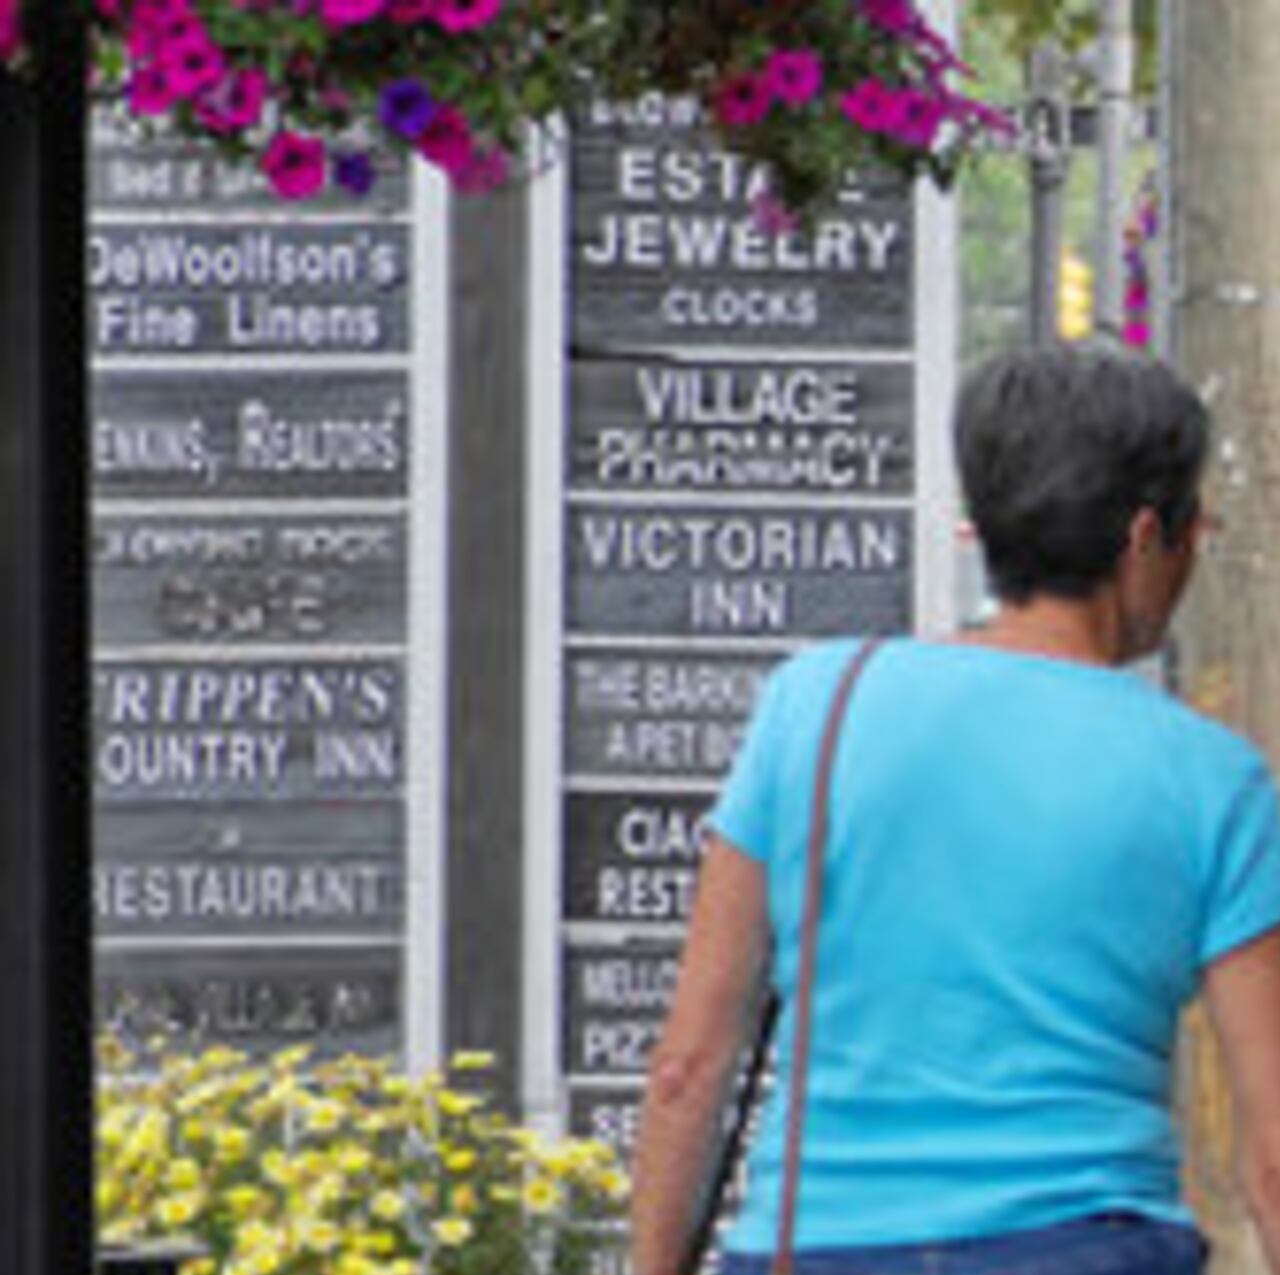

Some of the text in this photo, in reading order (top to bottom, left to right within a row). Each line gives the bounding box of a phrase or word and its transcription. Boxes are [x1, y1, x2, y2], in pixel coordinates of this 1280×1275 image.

[583, 214, 897, 269] JEWELRY
[100, 296, 381, 346] Fine Linens
[662, 289, 817, 325] CLOCKS
[637, 367, 858, 425] VILLAGE
[597, 428, 891, 486] PHARMACY
[581, 518, 897, 570] VICTORIAN
[690, 580, 787, 629] INN
[95, 667, 396, 724] RIPPEN'S
[575, 661, 641, 708] THE
[313, 731, 395, 781] INN
[636, 720, 695, 768] PET
